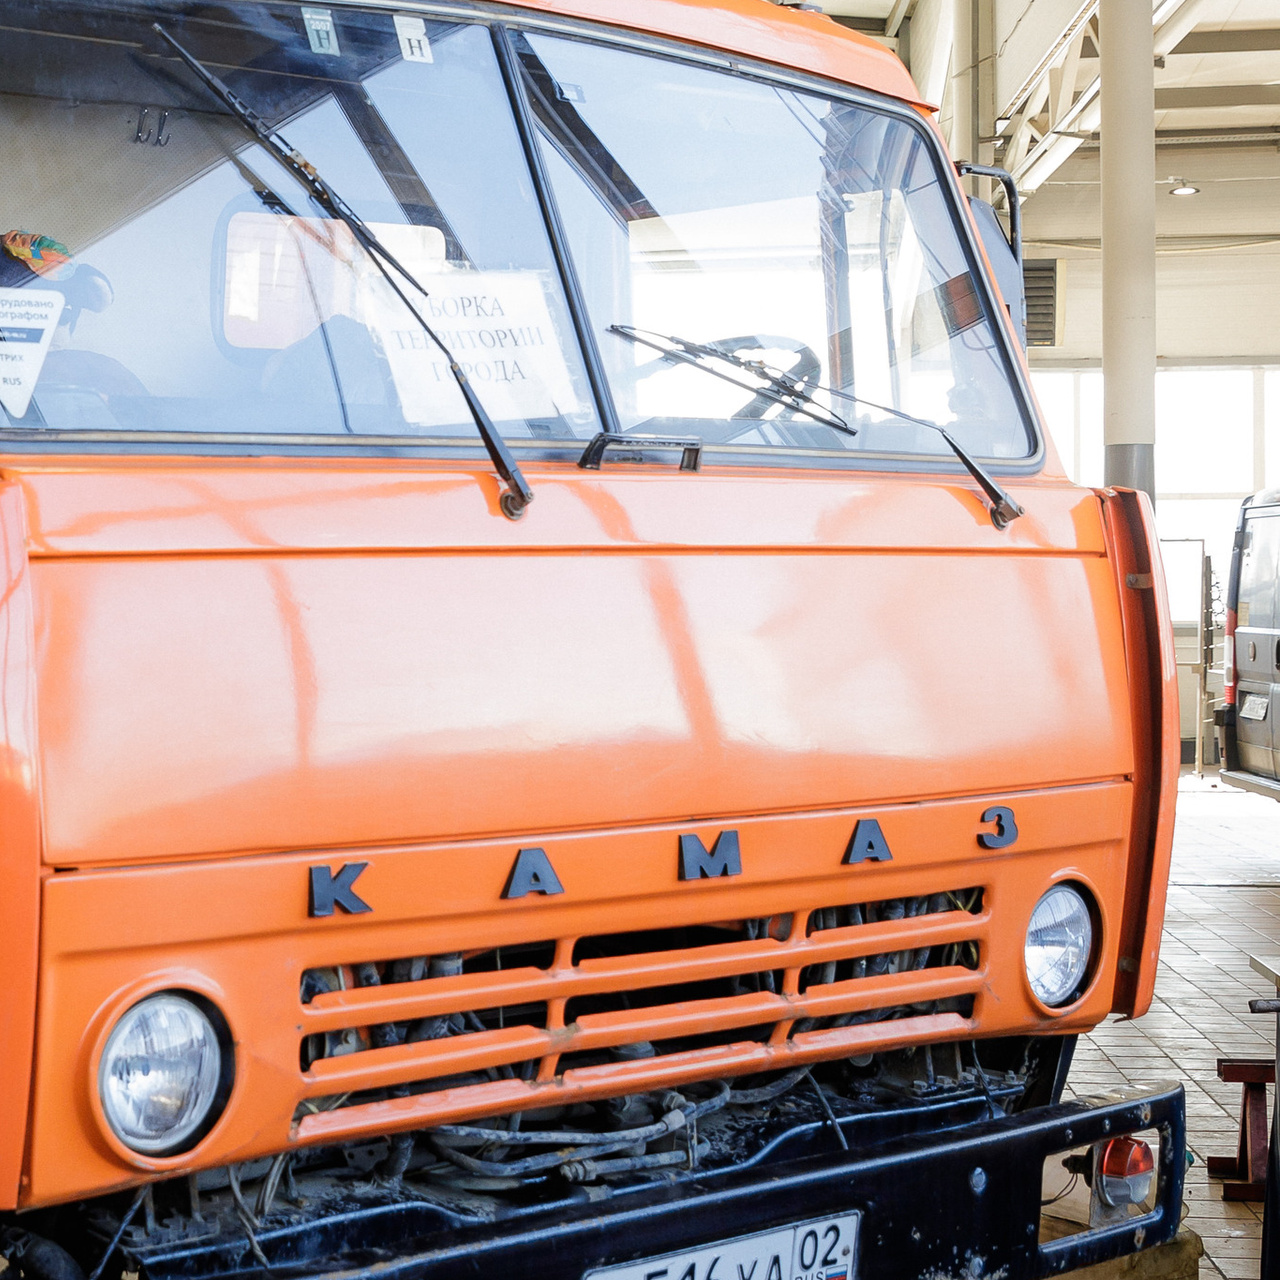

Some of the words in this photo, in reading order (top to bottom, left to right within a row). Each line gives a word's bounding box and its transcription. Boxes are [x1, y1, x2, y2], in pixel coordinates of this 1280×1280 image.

[2, 377, 22, 386] RUS
[308, 806, 1019, 918] КАМАЗ
[799, 1225, 840, 1271] 02
